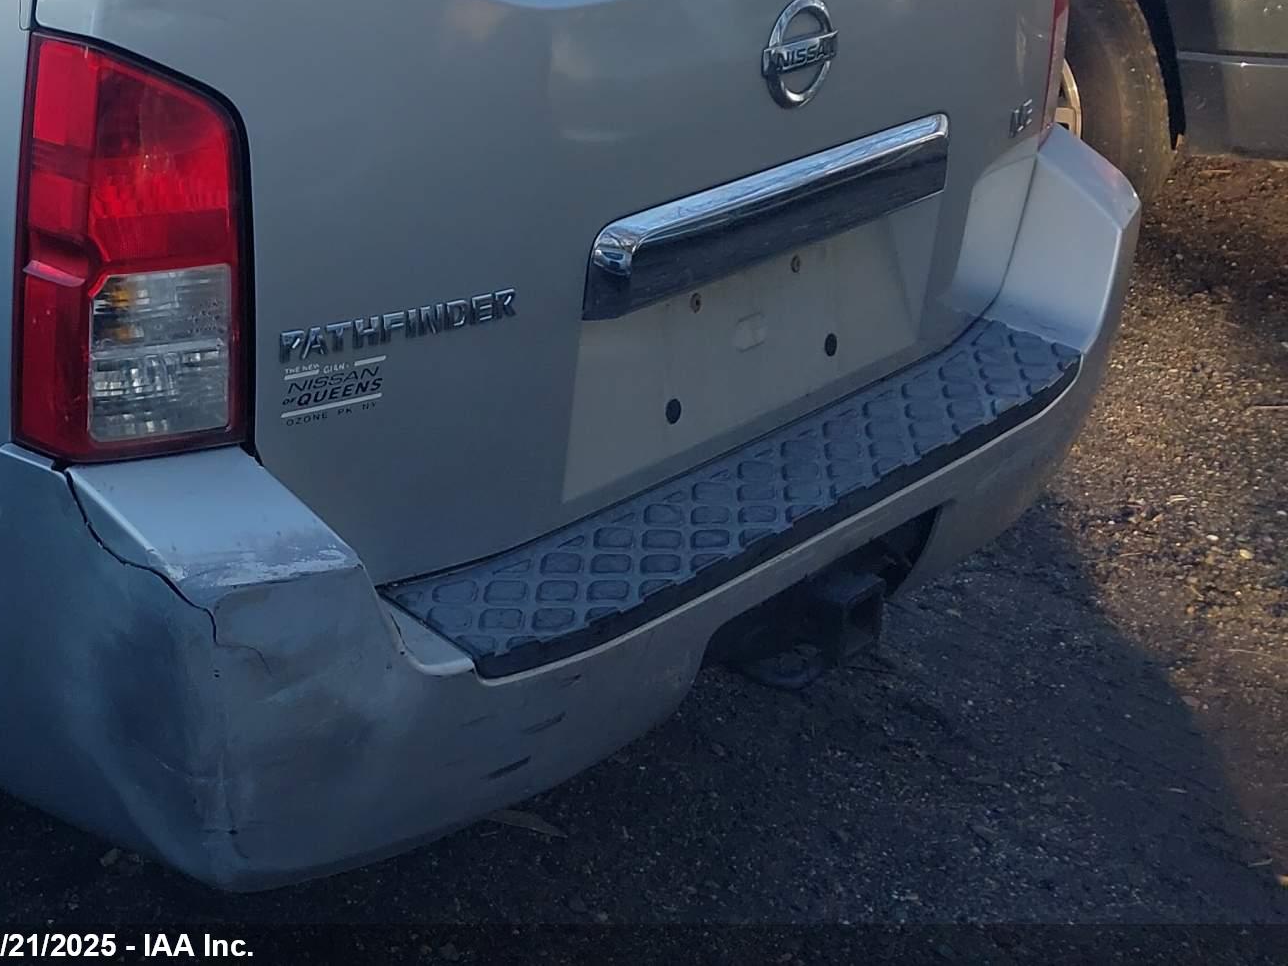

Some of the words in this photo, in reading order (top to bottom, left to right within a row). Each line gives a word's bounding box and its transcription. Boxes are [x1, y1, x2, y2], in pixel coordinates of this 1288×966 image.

[772, 40, 836, 71] NISSAN
[278, 287, 517, 364] PATHFINDER
[287, 365, 380, 395] NISSAN
[296, 376, 384, 408] QUEENS
[285, 412, 329, 428] OZONE
